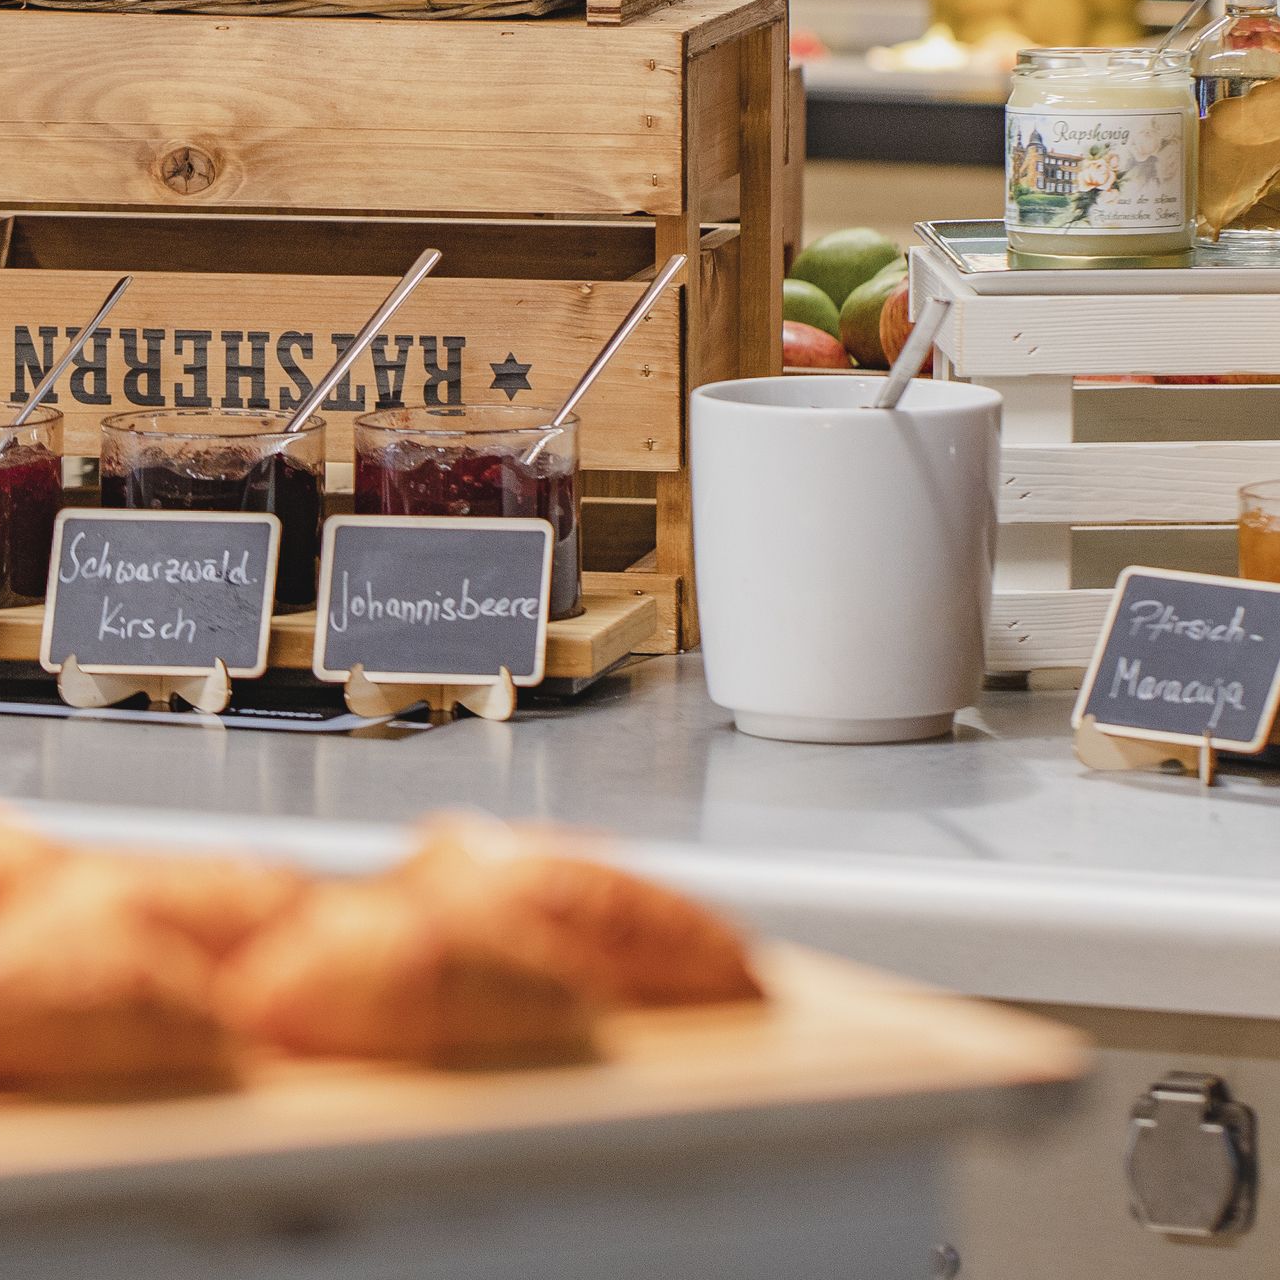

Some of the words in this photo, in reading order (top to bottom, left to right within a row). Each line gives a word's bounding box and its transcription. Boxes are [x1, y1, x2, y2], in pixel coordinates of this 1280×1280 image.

[10, 326, 466, 417] RATSHERRN
[97, 595, 198, 644] Kirsch
[330, 569, 539, 633] Johannisbeere
[1107, 656, 1247, 728] Maracuja
